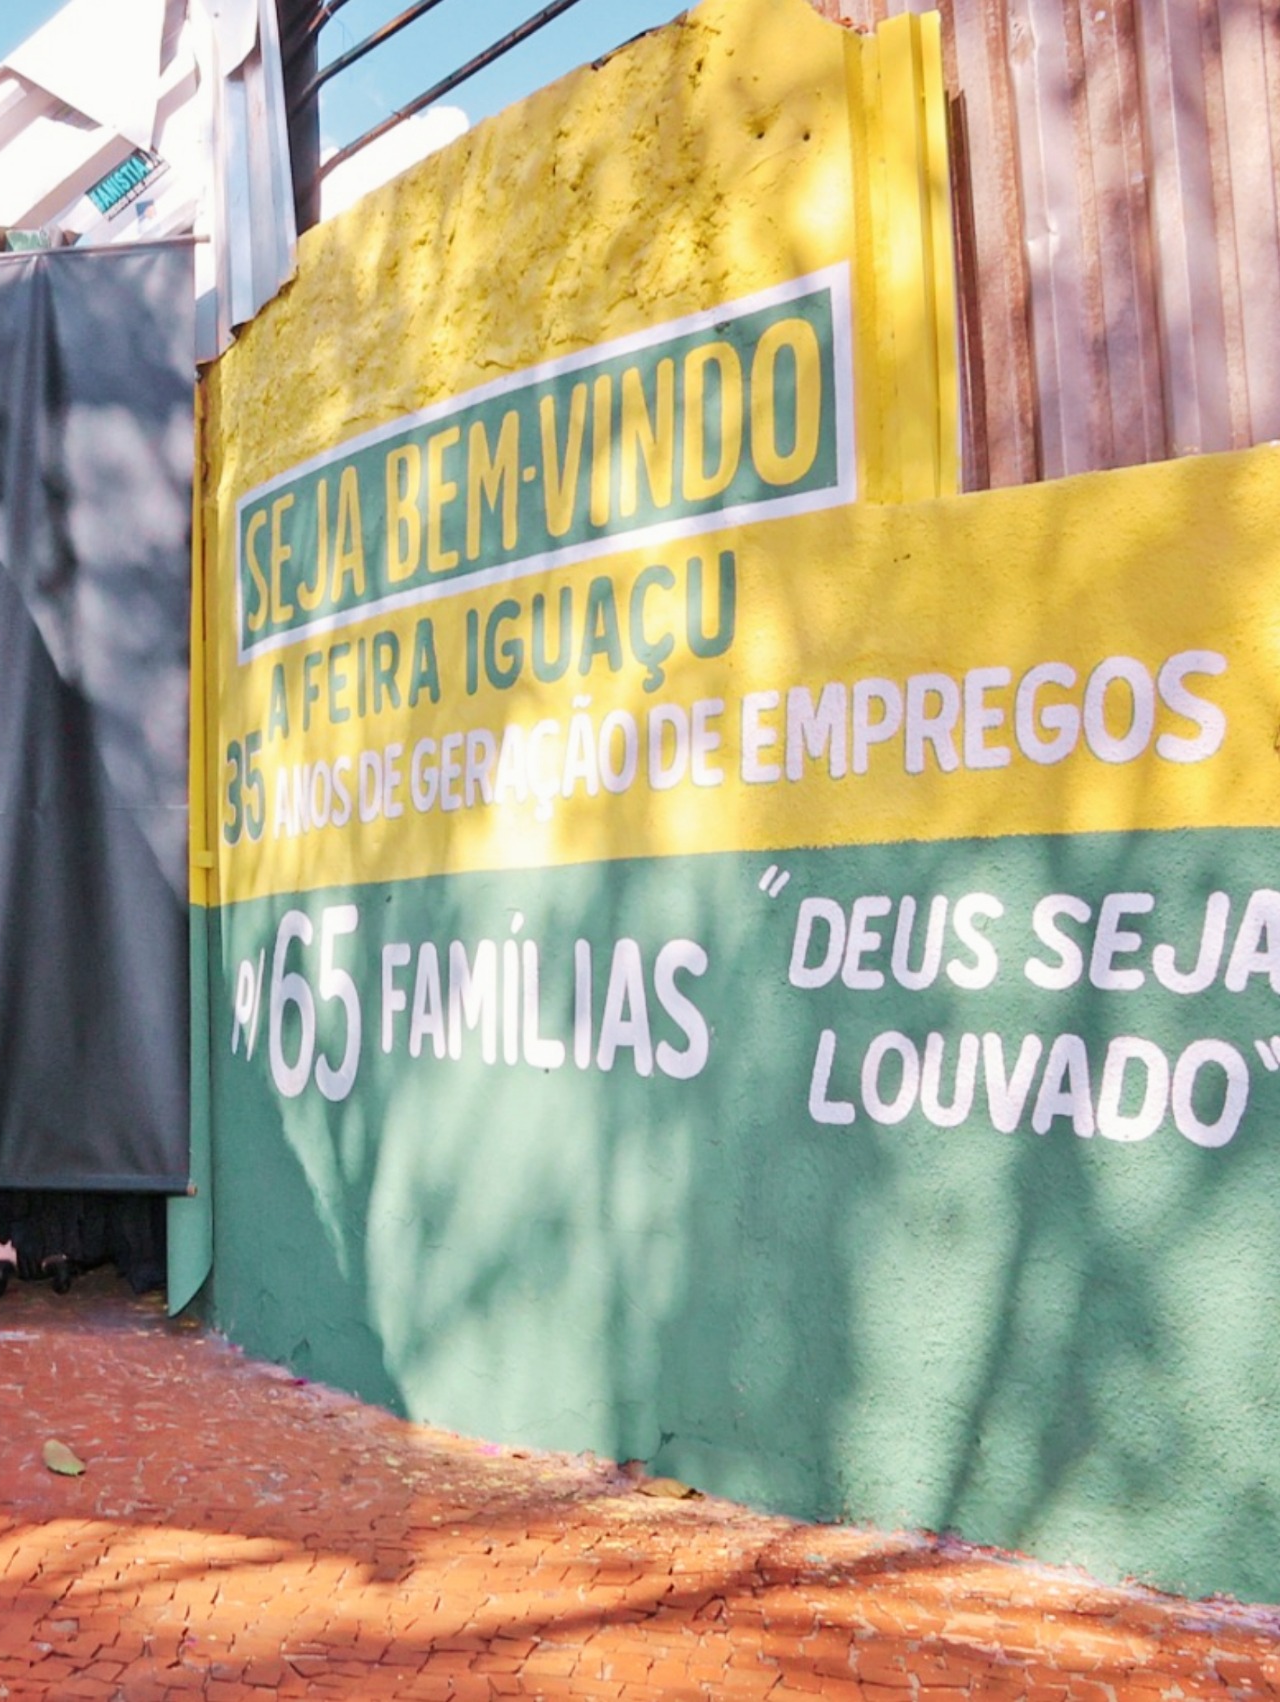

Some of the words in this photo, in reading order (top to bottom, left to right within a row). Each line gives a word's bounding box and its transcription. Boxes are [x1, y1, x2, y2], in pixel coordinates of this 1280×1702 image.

[245, 465, 365, 633] SEJA
[387, 317, 822, 584] BEM-VINDO
[268, 662, 288, 742] A
[303, 616, 440, 732] FEIRA
[466, 550, 736, 694] IGUAÇU
[223, 729, 266, 847] 35
[273, 756, 352, 840] ANOS
[358, 738, 403, 823] DE
[410, 693, 640, 820] GERAÇÃO
[648, 698, 724, 790] DE
[741, 649, 1228, 784] EMPREGOS
[269, 904, 362, 1102] 65
[381, 911, 710, 1080] FAMÍLIAS
[1026, 888, 1280, 994] SEJA
